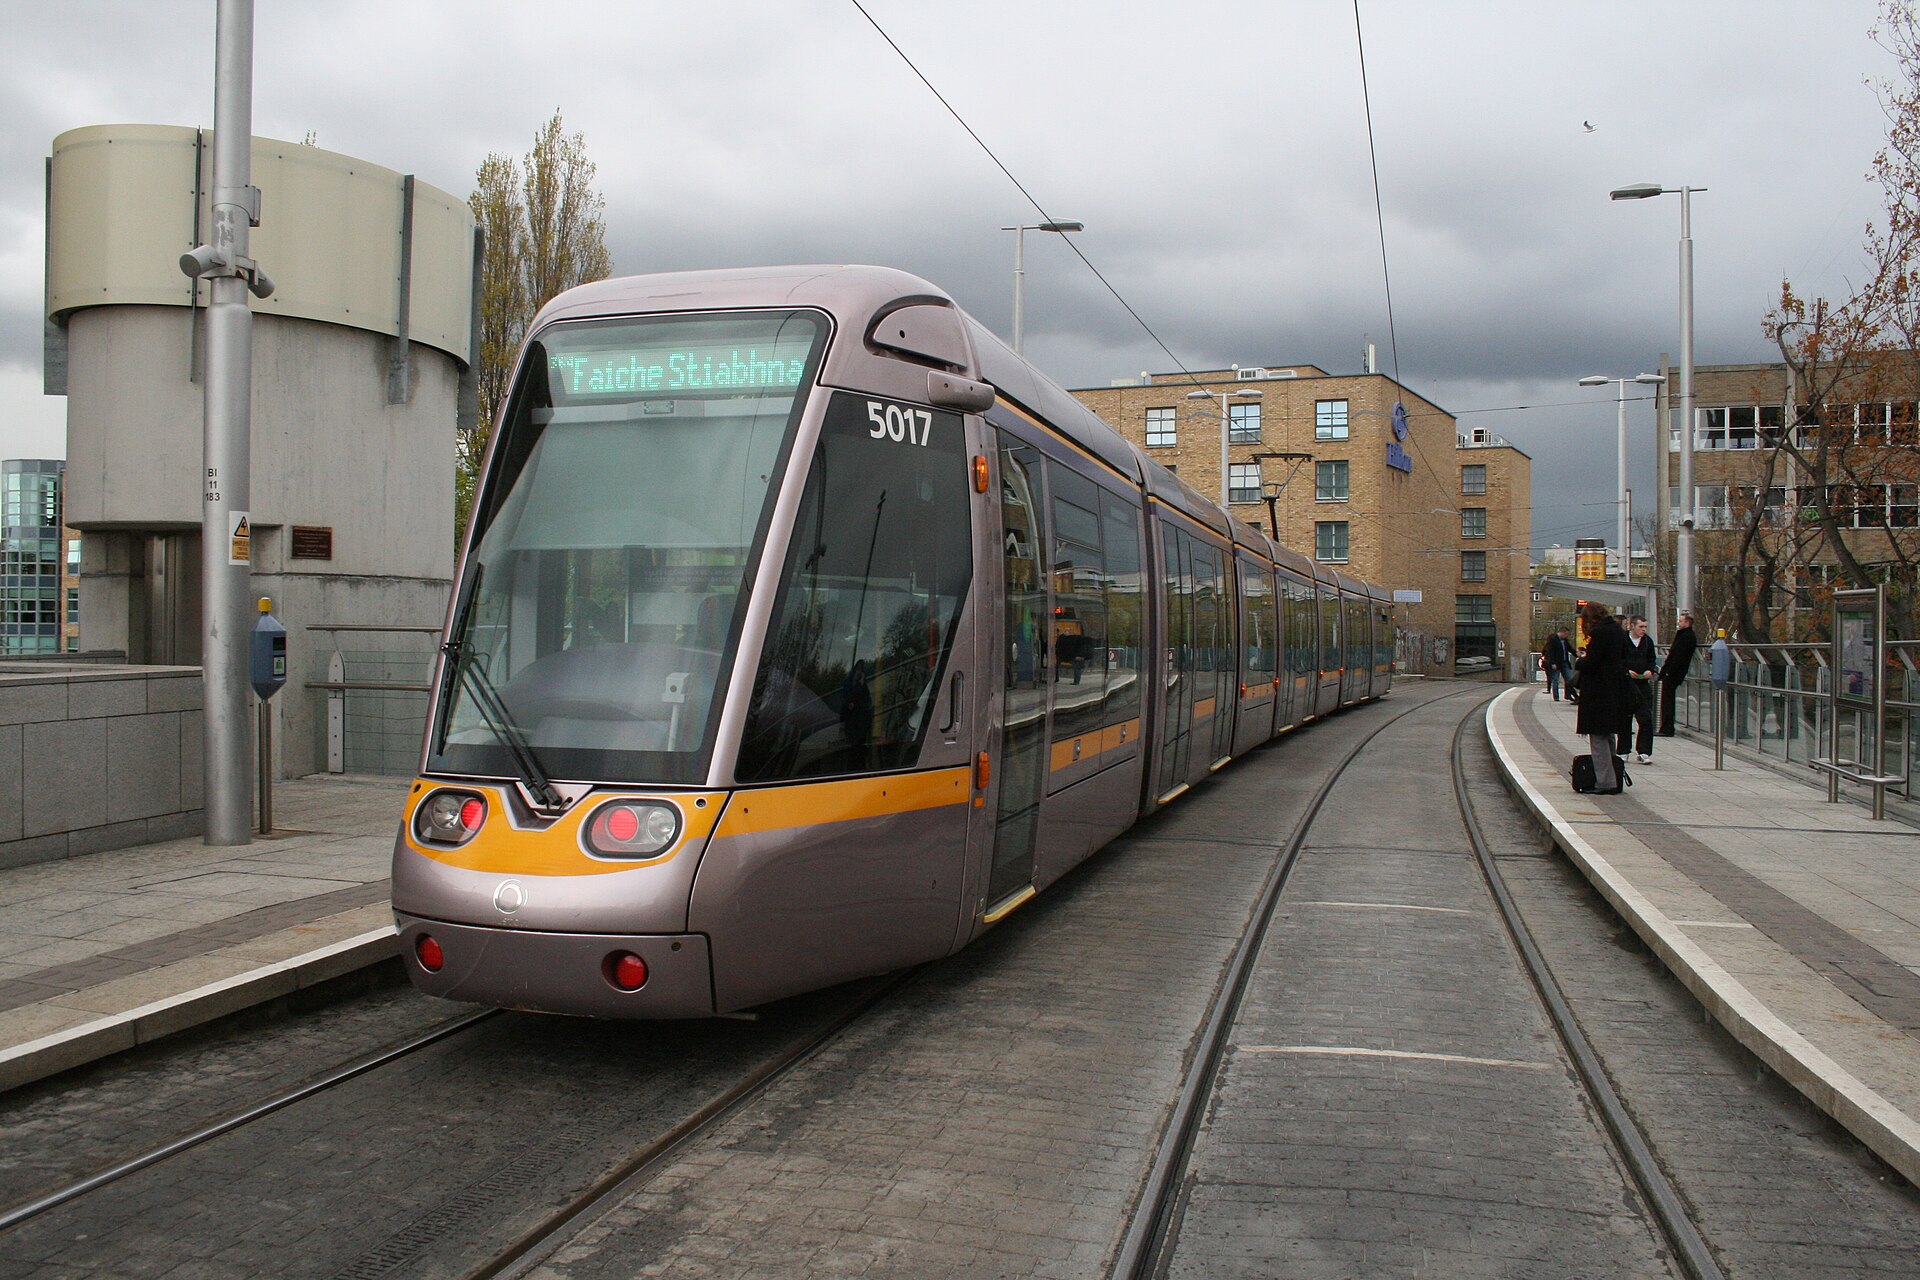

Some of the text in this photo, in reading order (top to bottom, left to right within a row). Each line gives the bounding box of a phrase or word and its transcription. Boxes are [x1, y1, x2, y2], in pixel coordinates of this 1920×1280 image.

[573, 356, 664, 391] Faiche
[668, 349, 804, 387] Stiabhna
[867, 400, 932, 447] 5017
[205, 492, 221, 502] 183
[209, 480, 218, 489] 11
